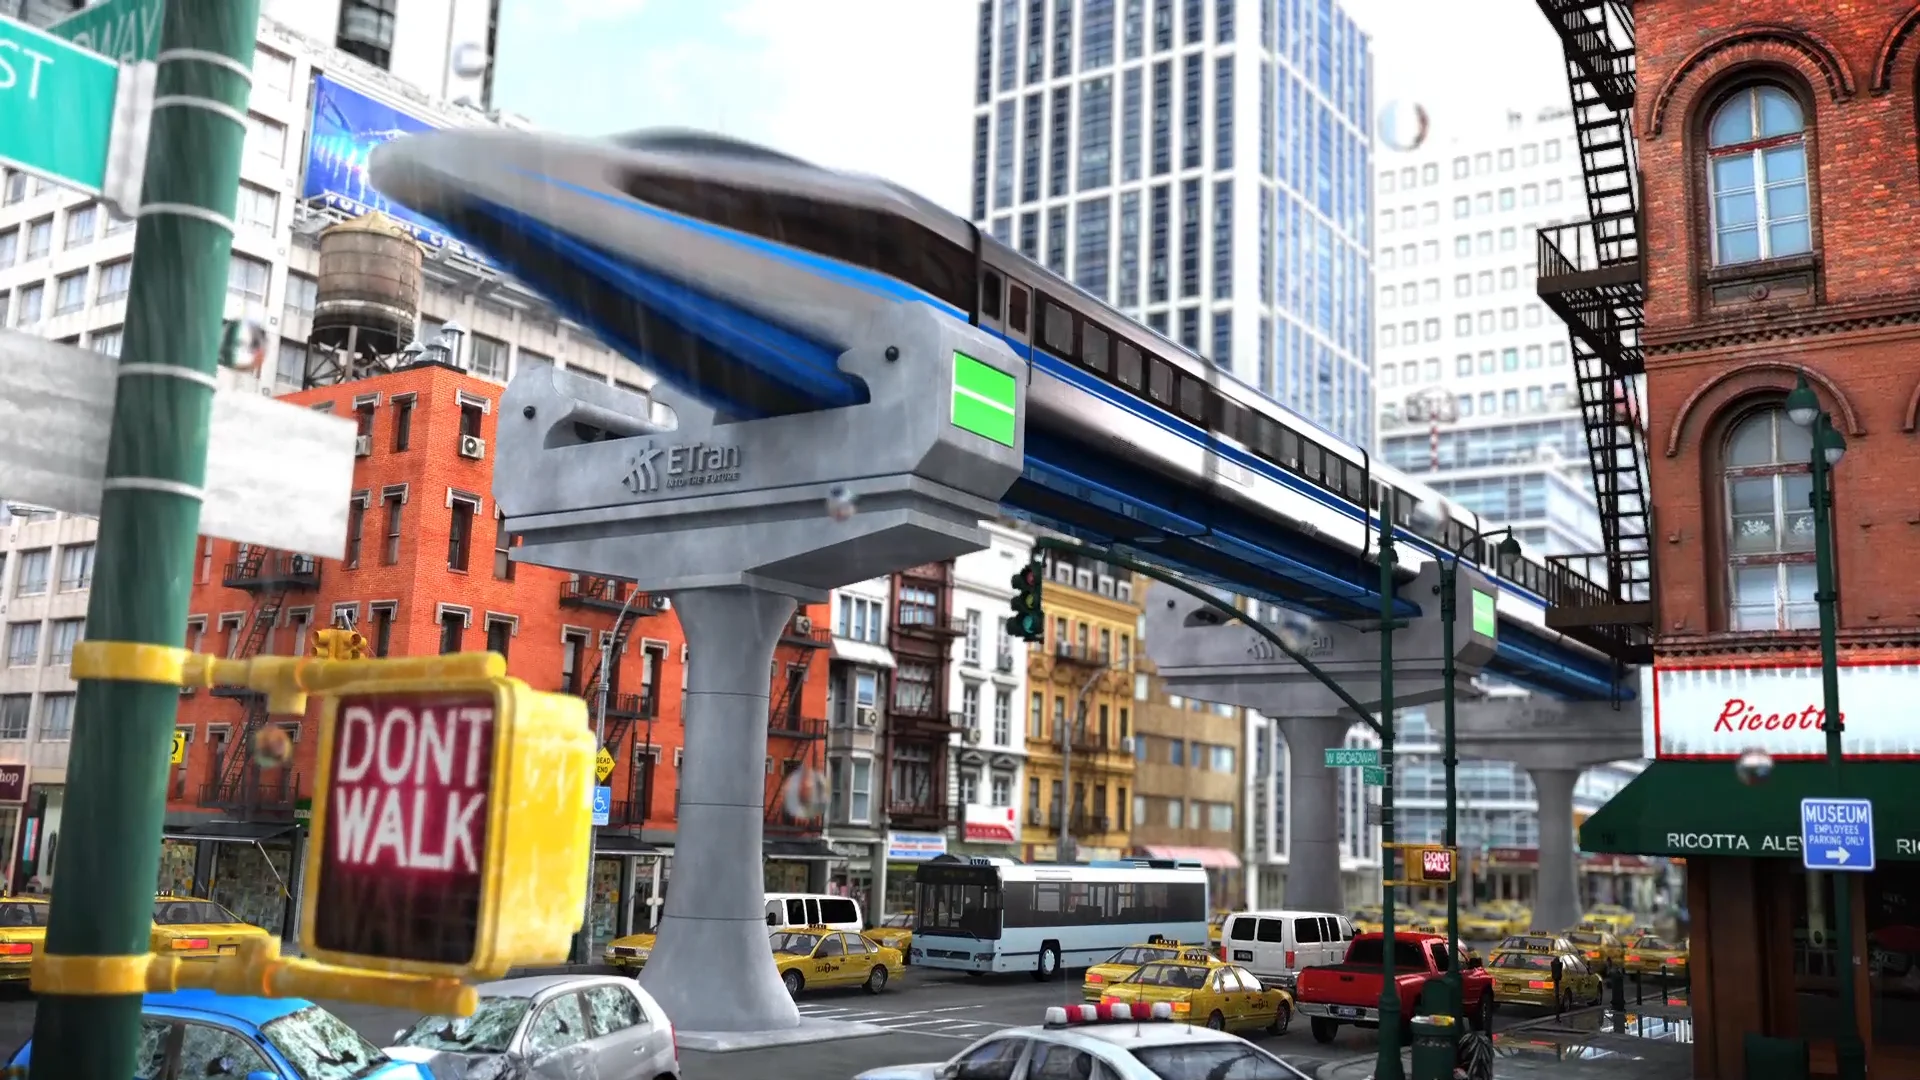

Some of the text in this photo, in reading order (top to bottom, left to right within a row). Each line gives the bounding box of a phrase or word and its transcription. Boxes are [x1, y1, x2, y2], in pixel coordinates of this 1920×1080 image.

[0, 39, 54, 99] ST
[667, 442, 741, 475] ETran
[666, 472, 740, 488] INTO THE FUTURE
[1713, 698, 1845, 732] Riccott
[338, 706, 493, 787] DONT
[1325, 751, 1377, 764] W BROADWAY
[1805, 804, 1868, 824] MUSEUM
[336, 787, 485, 873] WALK
[1814, 824, 1859, 835] EMPLOYEES
[1667, 832, 1750, 850] RICOTTA
[1809, 835, 1865, 846] PARKING ONLY
[1896, 838, 1920, 854] RI
[1424, 851, 1449, 861] DONT
[1424, 861, 1450, 871] WALK
